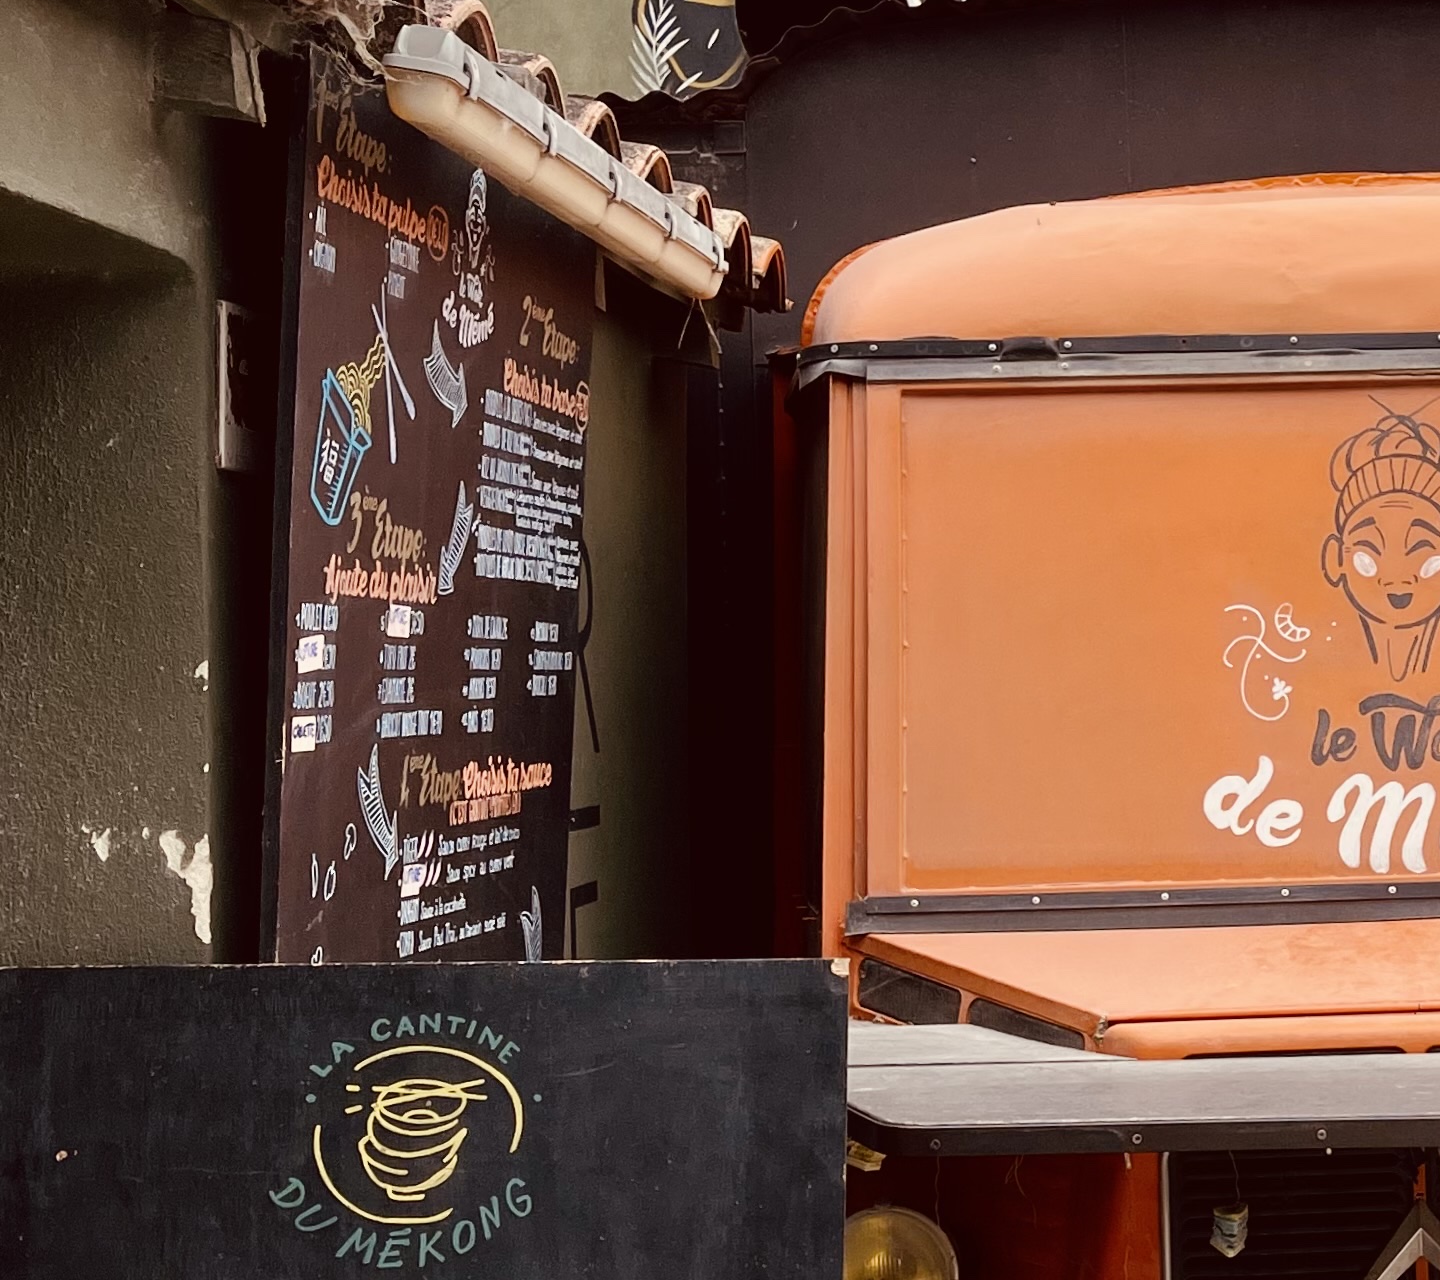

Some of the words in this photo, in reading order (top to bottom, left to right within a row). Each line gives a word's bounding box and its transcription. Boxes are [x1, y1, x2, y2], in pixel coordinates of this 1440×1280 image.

[442, 290, 458, 328] de
[324, 554, 369, 604] Ajoute
[369, 559, 389, 602] du
[389, 564, 438, 606] plaisir
[462, 755, 507, 799] Choisis
[520, 762, 553, 790] sauce
[1203, 755, 1304, 848] de
[309, 1041, 355, 1078] LA
[369, 1012, 521, 1069] CANTINE
[268, 1173, 341, 1232] DU
[332, 1174, 532, 1268] MÉKONG
